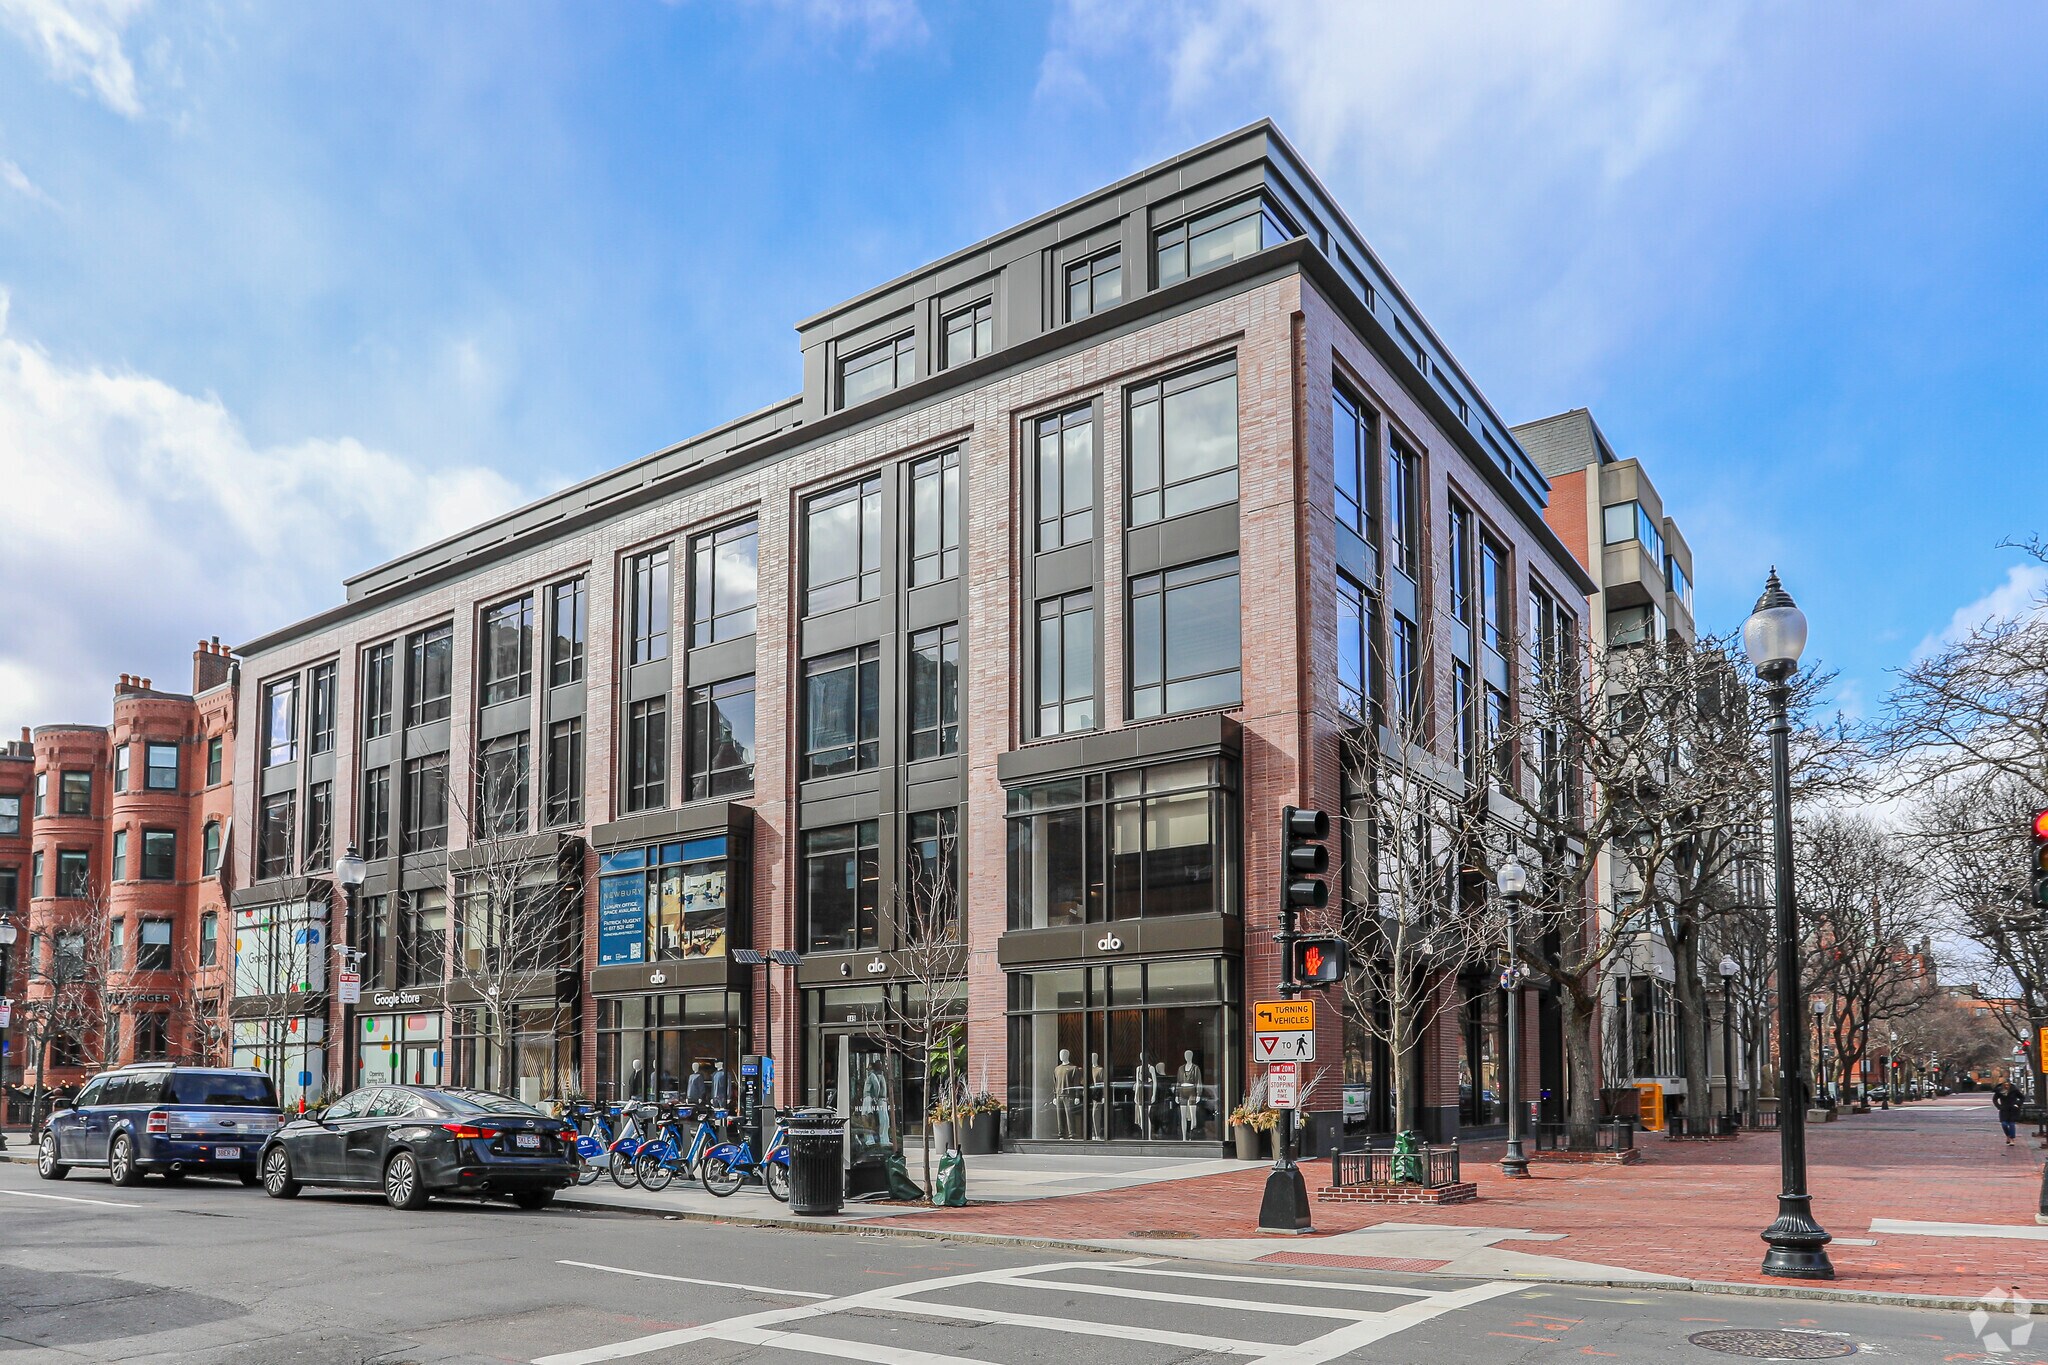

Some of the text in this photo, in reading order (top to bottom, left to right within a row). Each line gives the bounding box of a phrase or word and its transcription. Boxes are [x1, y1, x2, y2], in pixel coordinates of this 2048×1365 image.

[603, 888, 641, 899] NEWBURY
[618, 906, 641, 914] AVAILABLE
[1097, 932, 1121, 950] alo
[867, 957, 886, 973] alo
[374, 991, 420, 1008] Google Store
[1274, 1016, 1309, 1024] VEHICLES
[1282, 1041, 1292, 1049] TO
[1270, 1065, 1294, 1073] TOW ZONE
[369, 1071, 384, 1079] Opening
[367, 1077, 378, 1085] Spring
